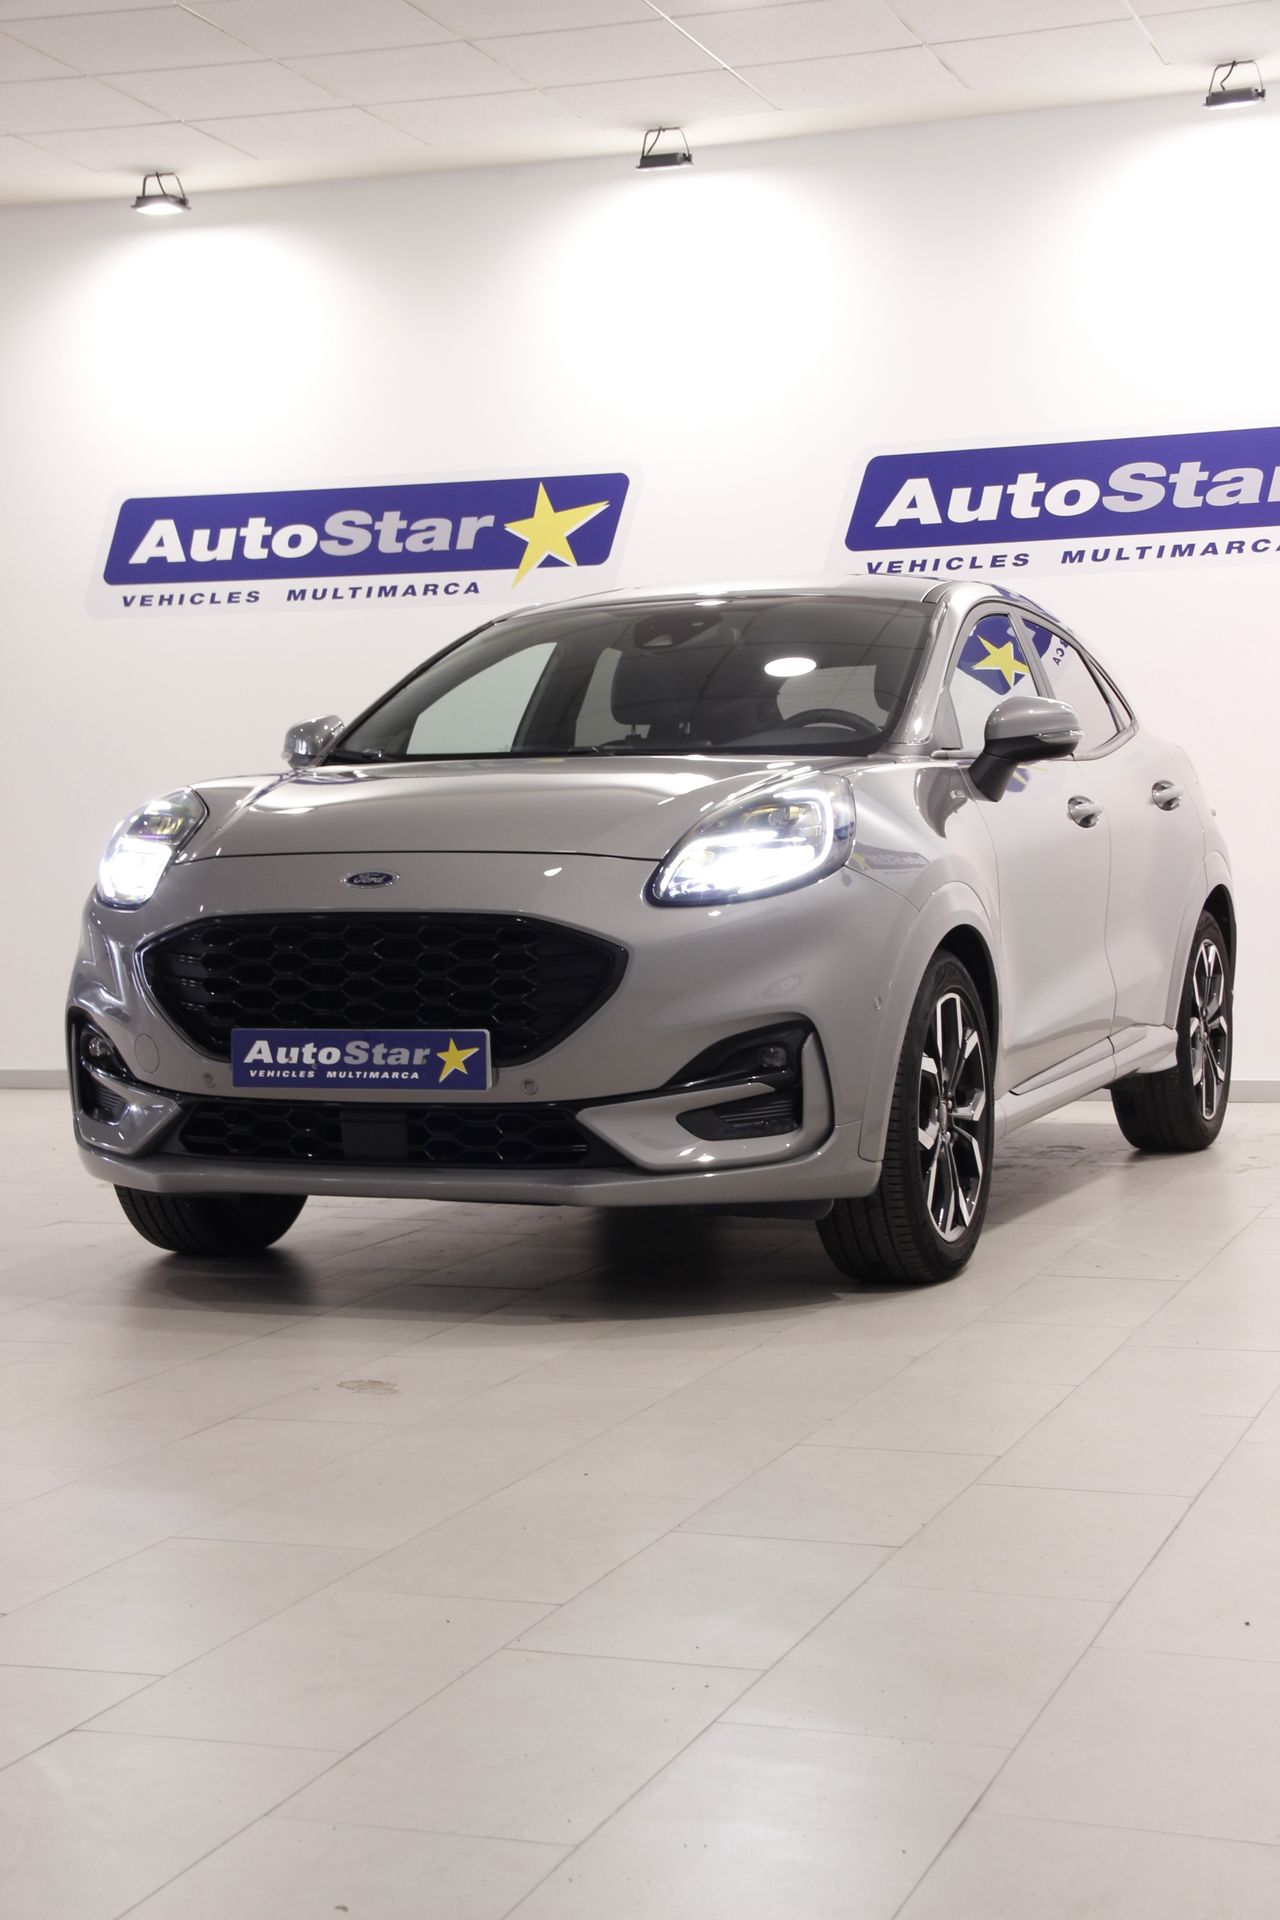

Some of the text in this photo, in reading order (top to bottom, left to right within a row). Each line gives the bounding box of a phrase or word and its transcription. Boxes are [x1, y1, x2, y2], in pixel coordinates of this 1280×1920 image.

[128, 510, 495, 565] AutoStar
[866, 552, 1030, 574] VEHICLES
[122, 582, 480, 608] VEHICLES MULTIMARCA
[243, 1040, 431, 1065] AutoStar
[249, 1070, 419, 1079] VEHICLES MULTIMARCA
